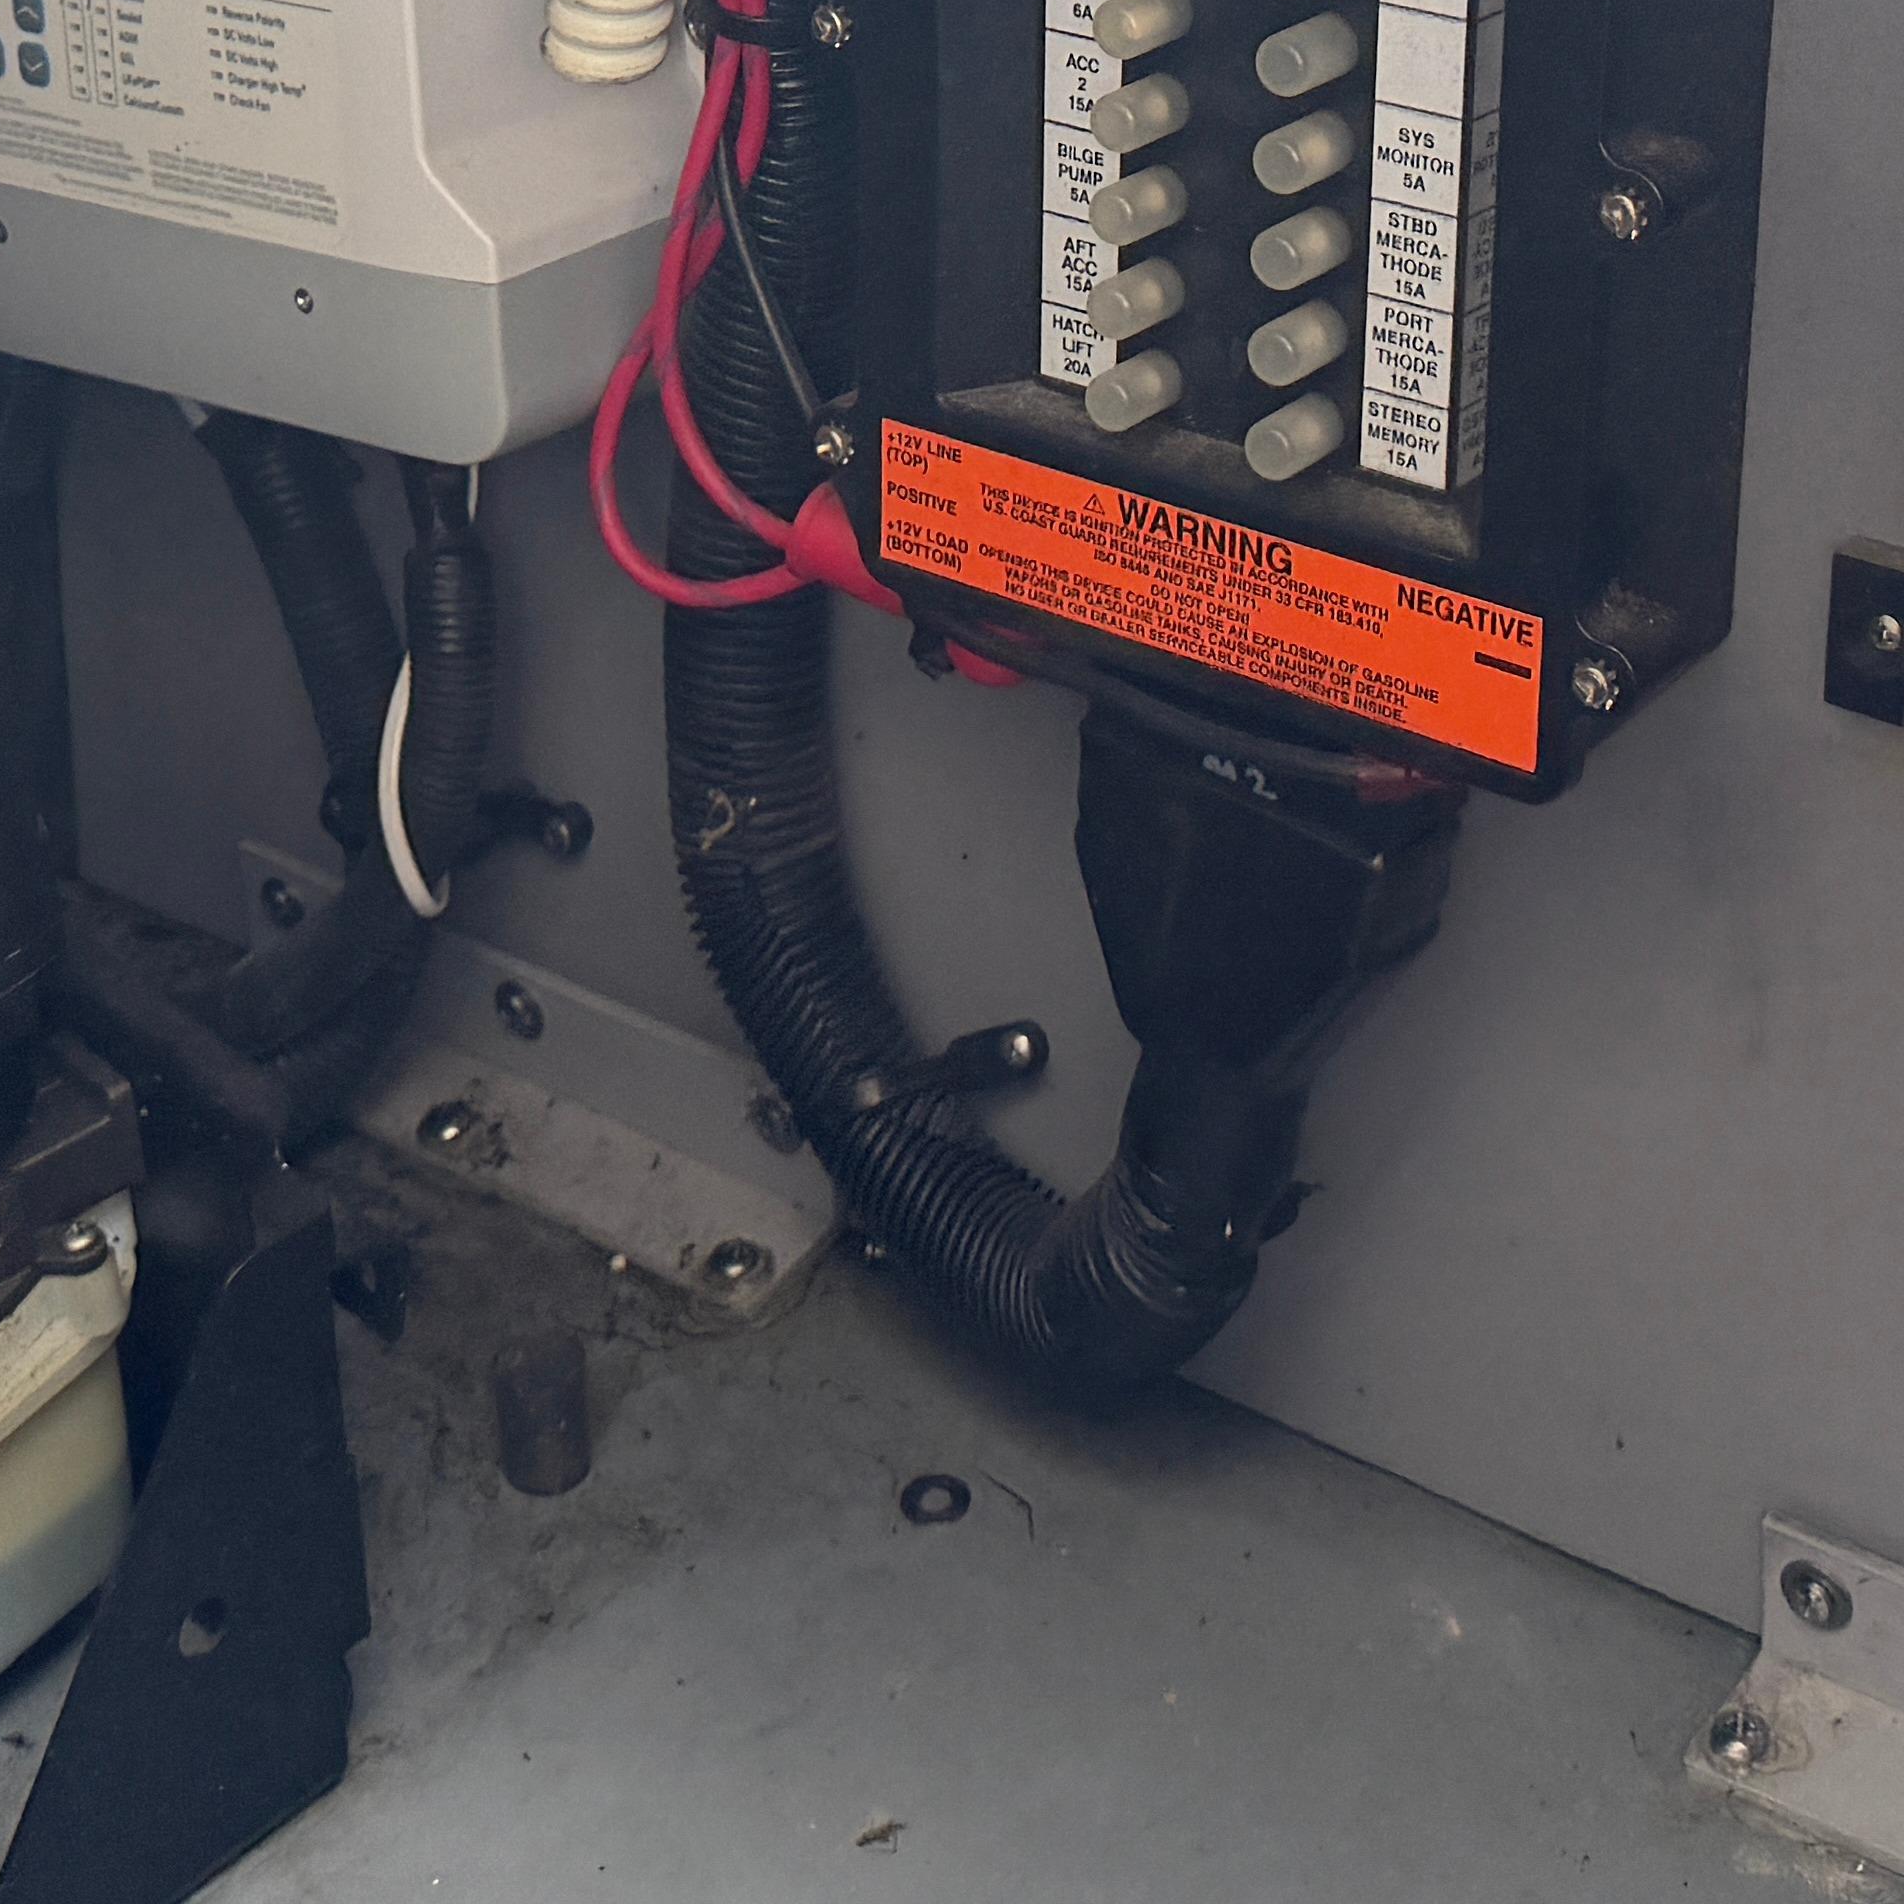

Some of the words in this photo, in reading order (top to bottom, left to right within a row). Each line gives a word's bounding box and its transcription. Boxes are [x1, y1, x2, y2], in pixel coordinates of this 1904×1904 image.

[1072, 3, 1094, 22] 6A
[1065, 52, 1101, 75] ACC
[1077, 76, 1087, 92] 2
[1068, 94, 1094, 113] 15A
[1398, 127, 1436, 149] SYS
[1057, 142, 1105, 167] BILGE
[1377, 145, 1456, 177] MONITOR
[1057, 163, 1104, 187] PUMP
[1402, 172, 1427, 193] 5A
[1070, 187, 1091, 206] 5A
[1387, 211, 1438, 238] STBD
[1063, 236, 1097, 258] AFT
[1376, 230, 1449, 261] MERCA-
[1061, 255, 1098, 277] ACC
[1380, 252, 1443, 282] THODE
[1065, 274, 1094, 293] 15A
[1395, 279, 1427, 300] 15A
[1384, 307, 1434, 333] PORT
[1061, 337, 1095, 359] LIFT
[1371, 325, 1444, 358] MERCA-
[1063, 357, 1093, 378] 20A
[1375, 346, 1439, 378] THODE
[1390, 373, 1423, 396] 15A
[1367, 400, 1442, 433] STEREO
[887, 431, 923, 451] +12V
[927, 440, 963, 464] LINE
[1366, 423, 1441, 456] MEMORY
[886, 446, 929, 475] (TOP)
[1387, 448, 1419, 472] 15A
[886, 480, 958, 517] POSITIVE
[886, 518, 923, 539] +12V
[926, 527, 969, 555] LOAD
[1118, 492, 1293, 577] WARNING
[886, 533, 963, 574] (BOTTOM)
[980, 481, 1010, 503] THIS
[1012, 492, 1061, 519] DEVICE
[1064, 508, 1078, 524] IS
[1080, 512, 1141, 543] IGNITION
[1142, 533, 1227, 571] PROTECTED
[1229, 560, 1245, 577] IN
[1247, 567, 1350, 610] ACCORDANCE
[1351, 597, 1390, 622] WITH
[982, 497, 1009, 517] U.S.
[1010, 506, 1056, 532] COAST
[1058, 521, 1107, 547] GUARD
[1109, 537, 1219, 584] REQUIREMENTS
[1222, 573, 1273, 600] UNDER
[1275, 589, 1293, 607] 33
[1294, 596, 1325, 618] CFR
[1093, 548, 1117, 566] ISO
[1153, 567, 1183, 587] AND
[1186, 576, 1216, 598] SAE
[1150, 583, 1172, 600] DO
[1174, 590, 1203, 610] NOT
[978, 542, 1039, 573] OPENING
[1040, 562, 1071, 584] THIS
[1072, 573, 1123, 600] DEVICE
[1125, 589, 1174, 617] COULD
[1177, 607, 1225, 635] CAUSE
[1228, 623, 1249, 641] AN
[1251, 631, 1335, 670] EXPLOSION
[1338, 658, 1360, 675] OF
[1362, 666, 1441, 705] GASOLINE
[1397, 582, 1535, 649] NEGATIVE
[1003, 565, 1058, 594] VAPORS
[1061, 584, 1082, 601] OR
[1083, 592, 1154, 626] GASOLINE
[1208, 631, 1272, 664] CAUSING
[1274, 652, 1328, 683] INJURY
[1329, 671, 1352, 690] OR
[1355, 679, 1409, 710] DEATH.
[1004, 580, 1026, 597] NO
[1027, 588, 1065, 611] USER
[1067, 601, 1088, 619] OR
[1090, 608, 1146, 638] DEALER
[1148, 627, 1246, 670] SERVICEABLE
[1248, 659, 1351, 706] COMPONENTS
[1352, 694, 1408, 725] INSIDE.
